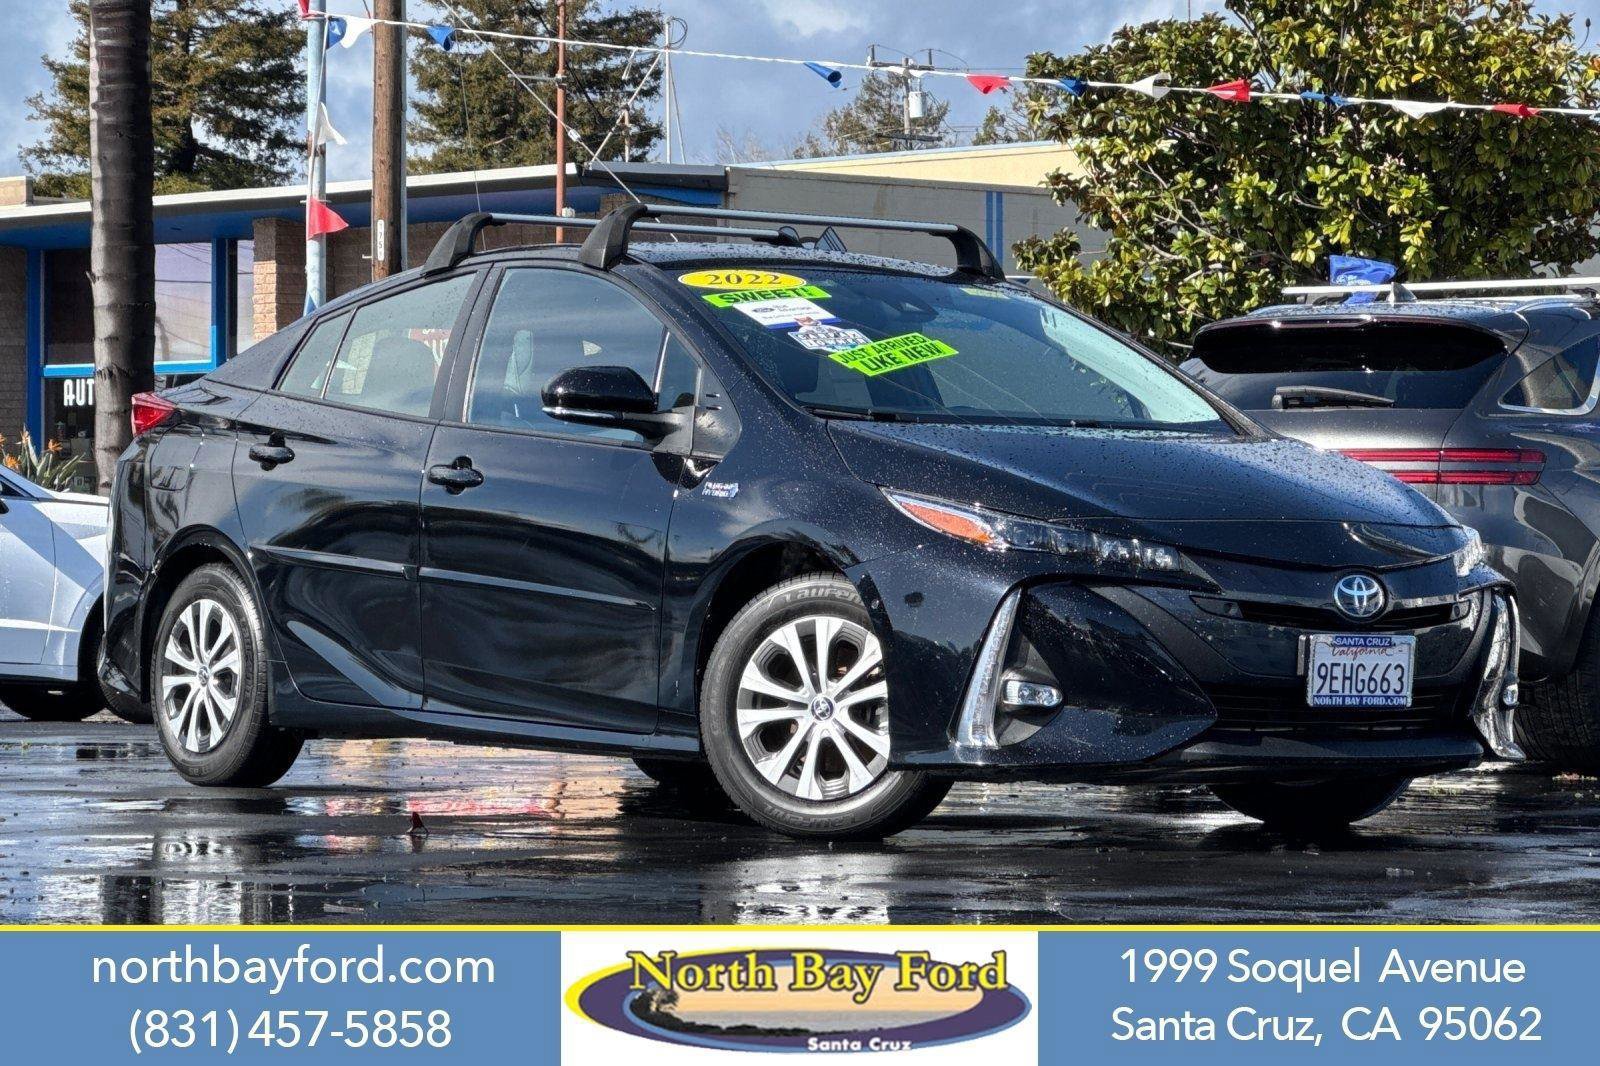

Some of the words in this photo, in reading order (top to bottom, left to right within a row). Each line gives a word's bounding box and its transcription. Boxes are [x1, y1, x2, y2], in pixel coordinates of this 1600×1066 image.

[704, 273, 782, 285] 2022
[717, 286, 814, 304] SWEET!
[838, 347, 870, 363] JUST
[871, 334, 927, 354] ARRIVED
[860, 351, 902, 371] LIKE
[901, 342, 943, 361] NEW
[63, 378, 95, 406] AUT
[1335, 637, 1365, 646] SANTA
[1366, 637, 1391, 646] CRUZ
[1332, 646, 1393, 660] California
[1316, 662, 1405, 694] 9EHG663
[1313, 696, 1342, 705] NORTH
[1345, 696, 1360, 705] BAY
[1362, 696, 1407, 705] FORD.COM
